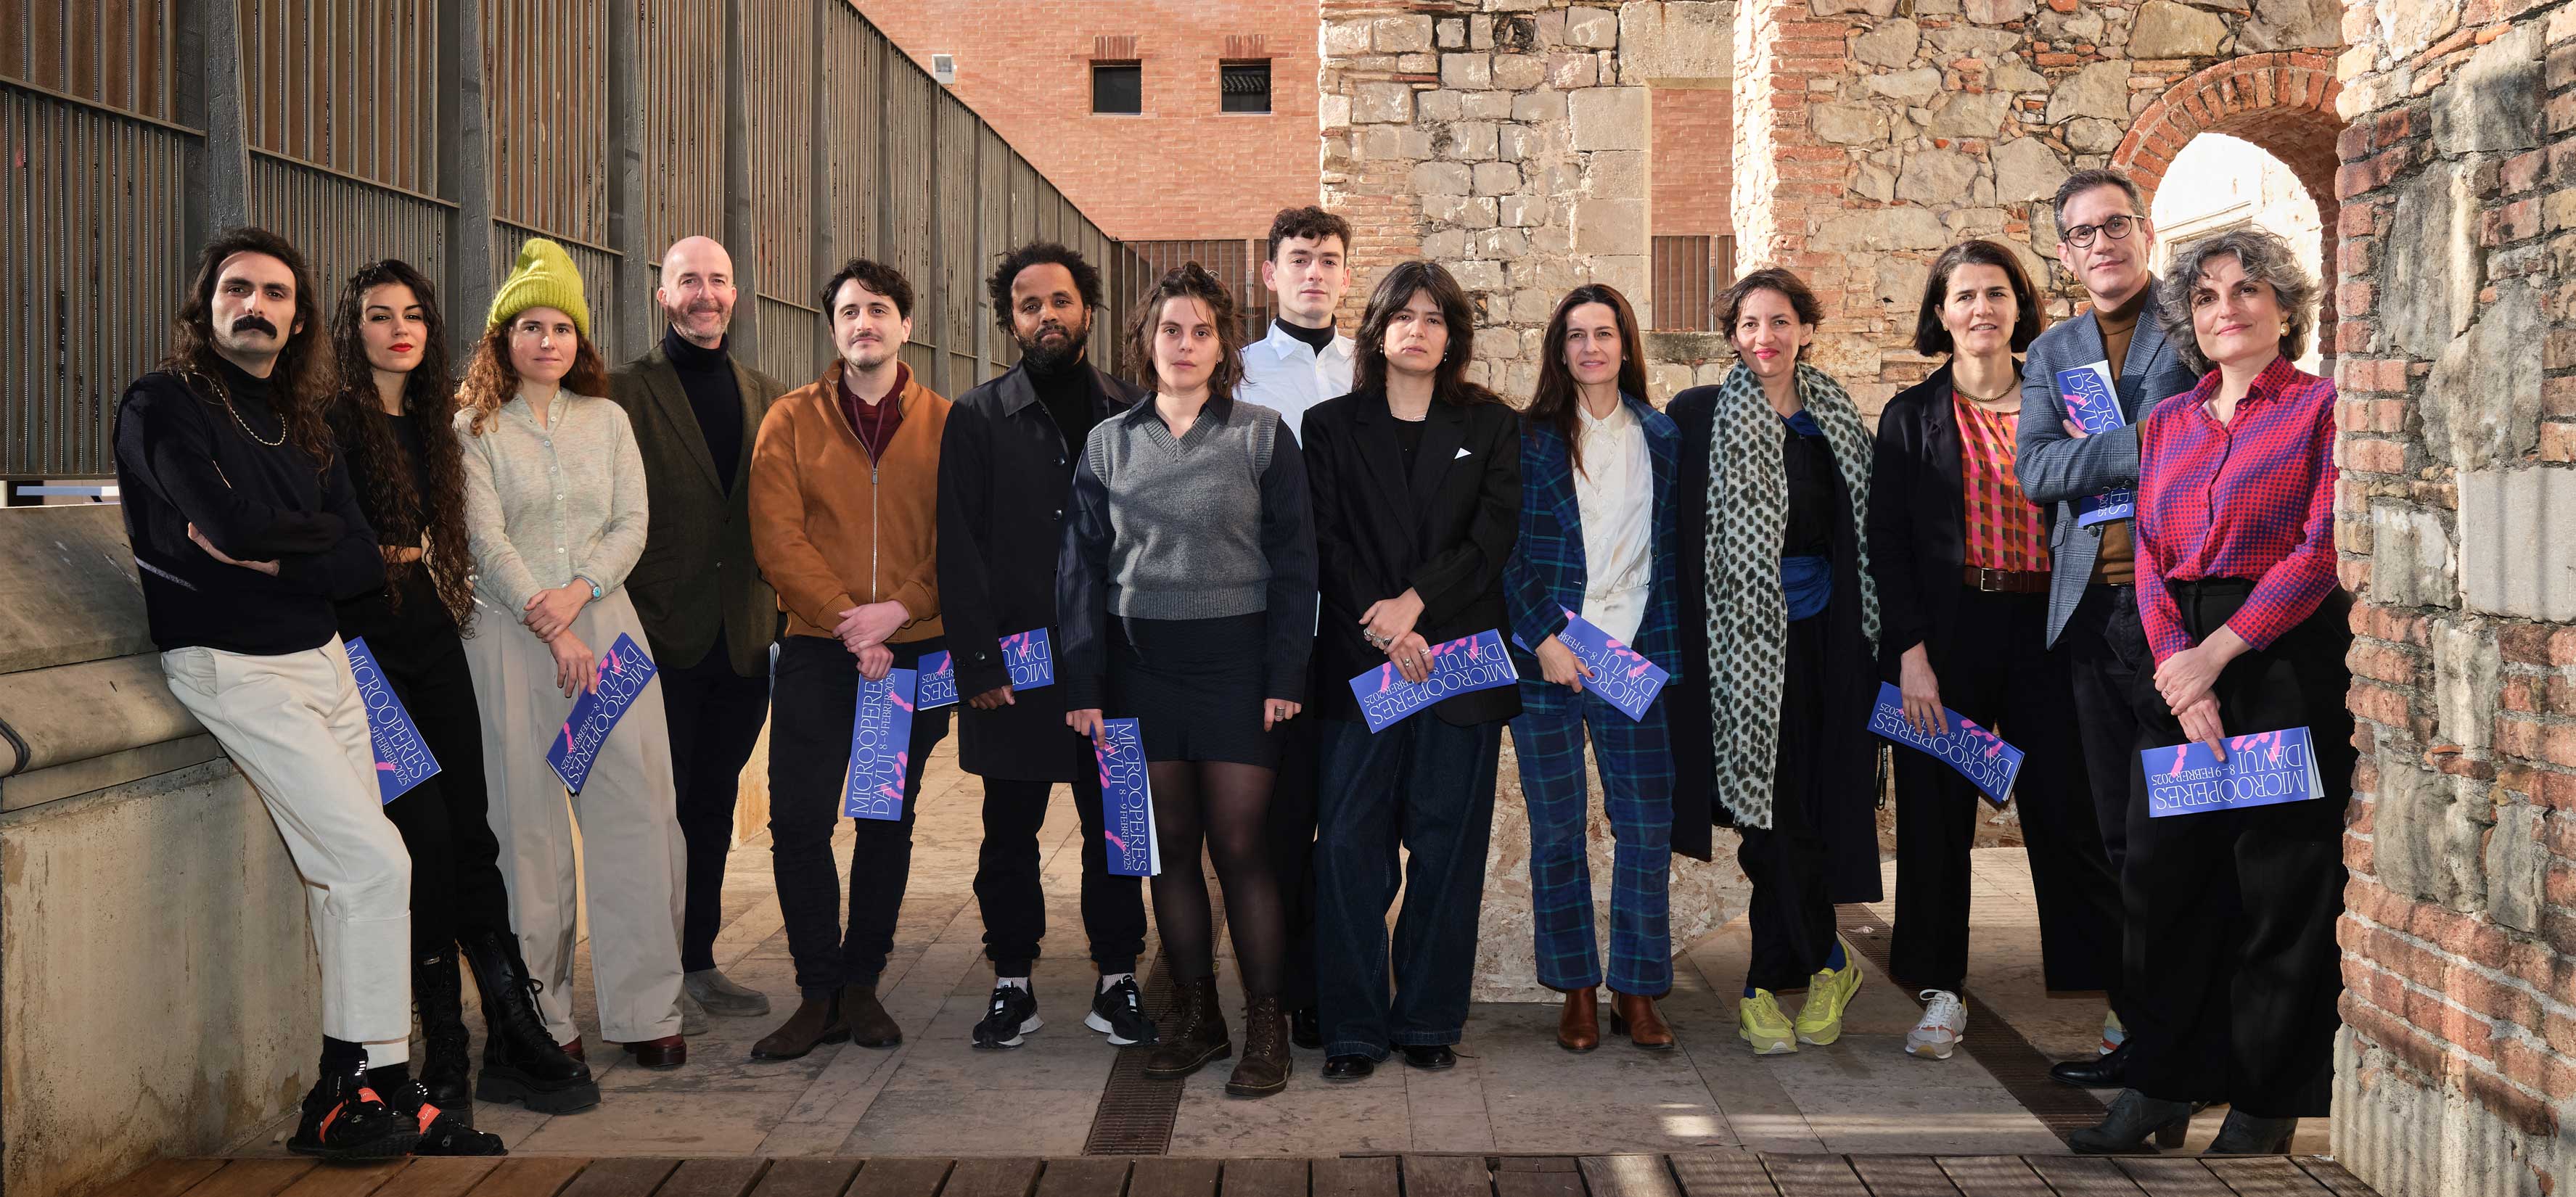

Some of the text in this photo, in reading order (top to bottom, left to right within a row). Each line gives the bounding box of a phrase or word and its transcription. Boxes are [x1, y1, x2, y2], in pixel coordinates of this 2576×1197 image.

[2067, 373, 2103, 434] D'AVU
[2081, 371, 2120, 432] MICRO
[1001, 641, 1047, 667] D'AVU
[1439, 643, 1504, 672] D'AVUI
[1558, 632, 1581, 649] FEBR
[596, 644, 639, 704] D'AVUI
[885, 673, 896, 693] 2025
[922, 672, 940, 683] 2025
[1369, 662, 1510, 725] MICROÒPERES
[1576, 657, 1649, 715] MICRO
[1599, 649, 1660, 698] D'AVUI
[345, 643, 431, 779] MICROÒPERES
[880, 692, 893, 730] FEBRER
[1363, 689, 1385, 707] 2025
[1880, 702, 1900, 717] 2025
[567, 658, 652, 784] MICROÒPERES
[570, 720, 589, 753] FEBRER
[373, 732, 398, 770] FEBRER
[393, 764, 411, 786] 2025
[560, 752, 574, 772] 2025
[850, 678, 884, 815] MICROÒPERE
[1104, 724, 1126, 784] D'AVUI
[1874, 712, 2007, 796] MICROÒPERES
[1958, 729, 2014, 779] D'AVUI
[2237, 744, 2303, 774] D'AVUI
[871, 754, 896, 816] D'AVUI
[2151, 772, 2176, 786] 2025
[2154, 770, 2305, 810] MICROÒPERES
[2175, 767, 2214, 781] FEBRER
[1116, 723, 1147, 871] MICROÒPERES
[1120, 810, 1130, 848] FEBRER
[1123, 850, 1131, 871] 2025
